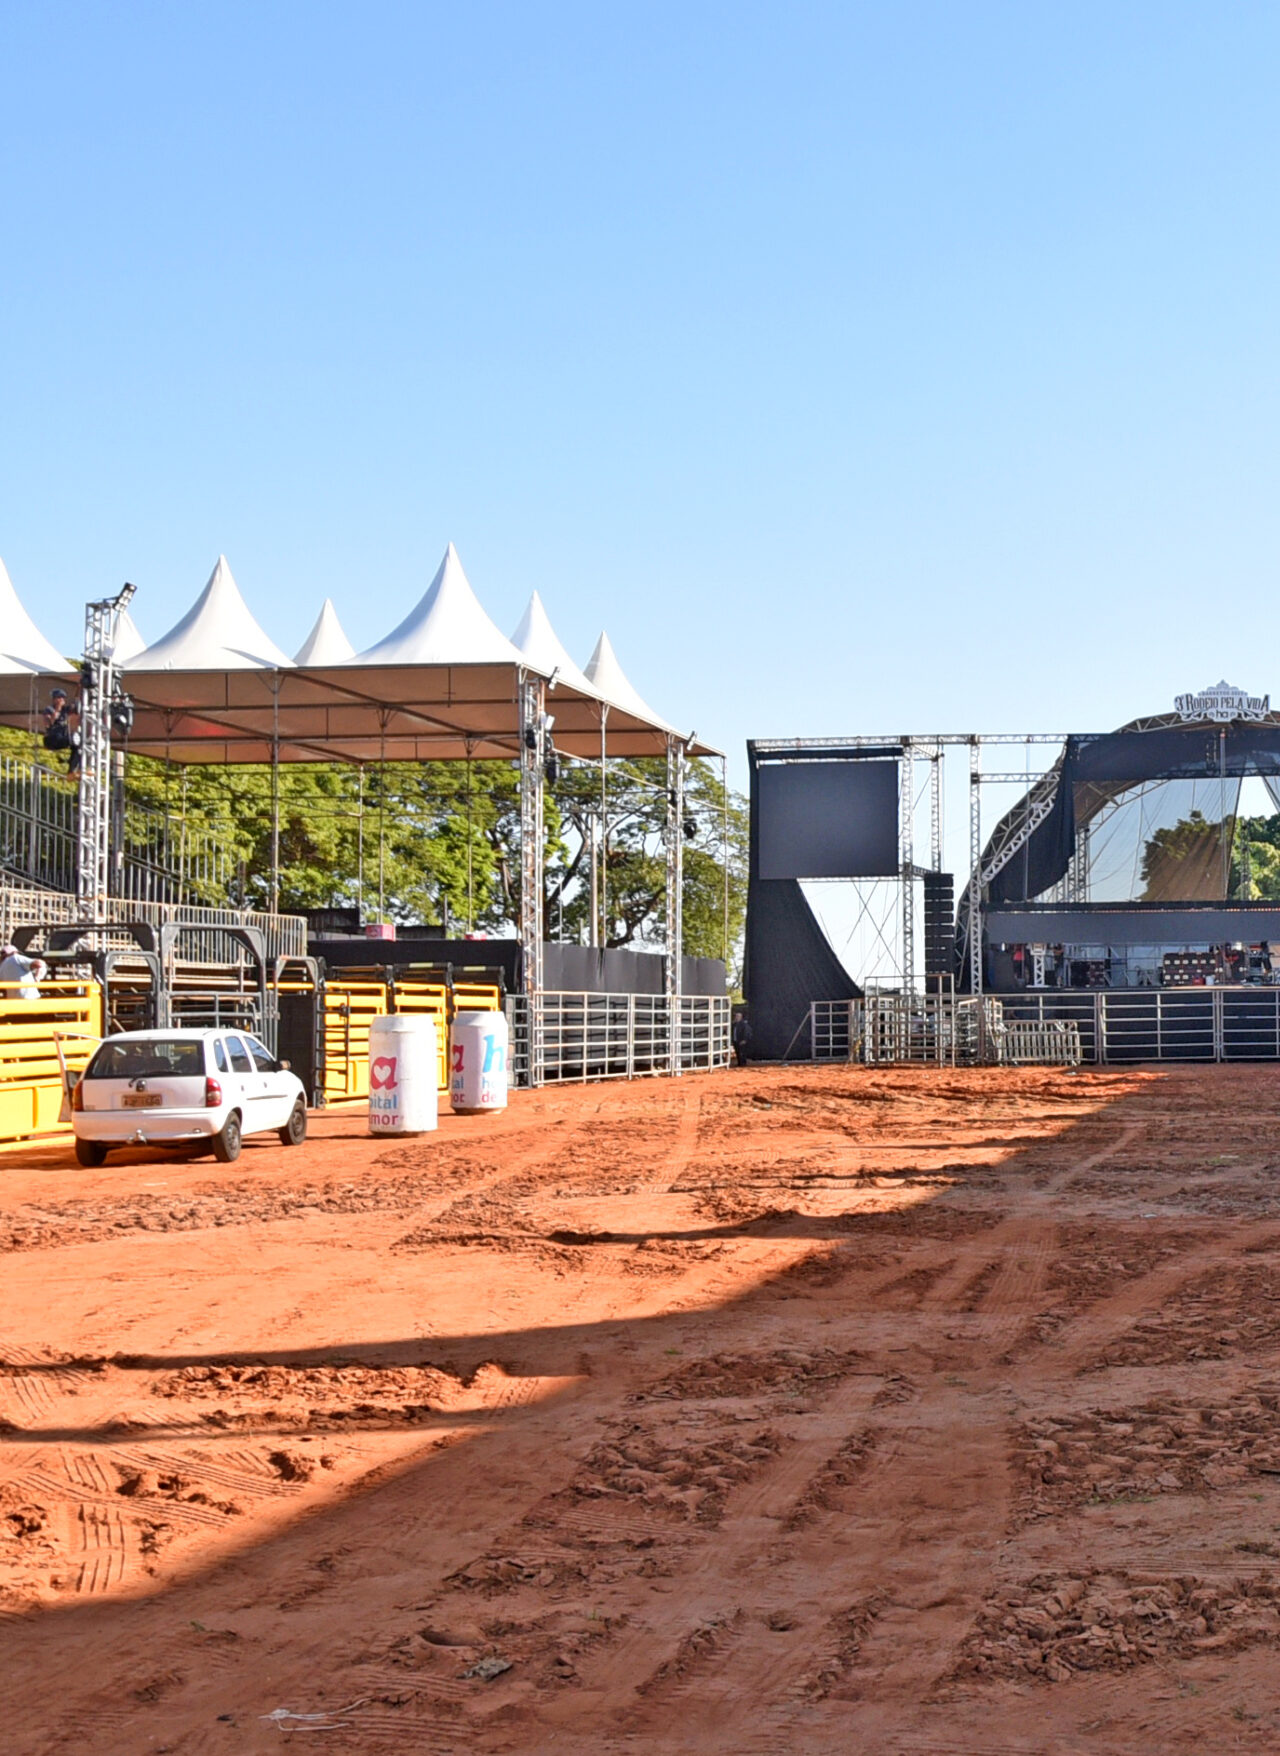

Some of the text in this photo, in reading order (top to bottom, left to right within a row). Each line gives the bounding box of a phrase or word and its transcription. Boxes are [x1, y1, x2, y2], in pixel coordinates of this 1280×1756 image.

[1220, 697, 1243, 709] PELA
[1246, 694, 1269, 712] VIDA
[370, 1056, 398, 1090] a
